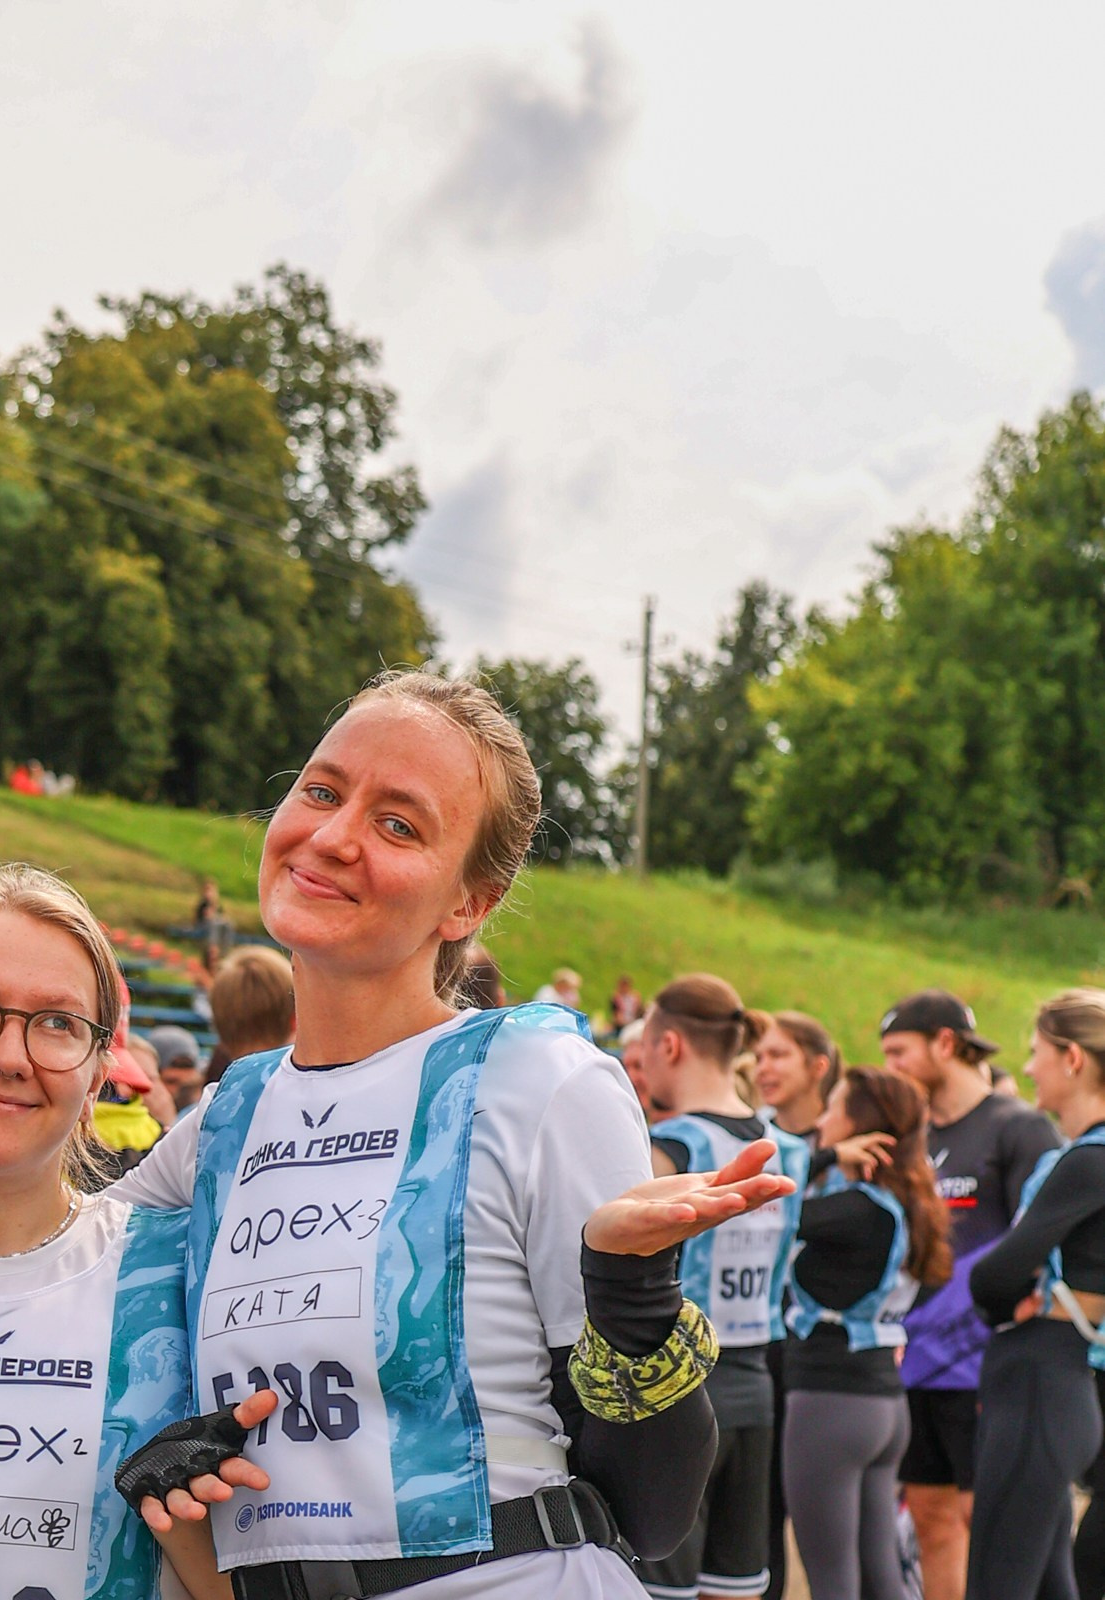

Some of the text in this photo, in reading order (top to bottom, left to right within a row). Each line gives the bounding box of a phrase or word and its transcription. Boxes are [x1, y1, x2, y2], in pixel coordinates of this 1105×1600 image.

[242, 1129, 399, 1177] ГОНКА ГЕРОЕВ
[230, 1199, 363, 1259] apex
[225, 1283, 321, 1328] КАТЯ
